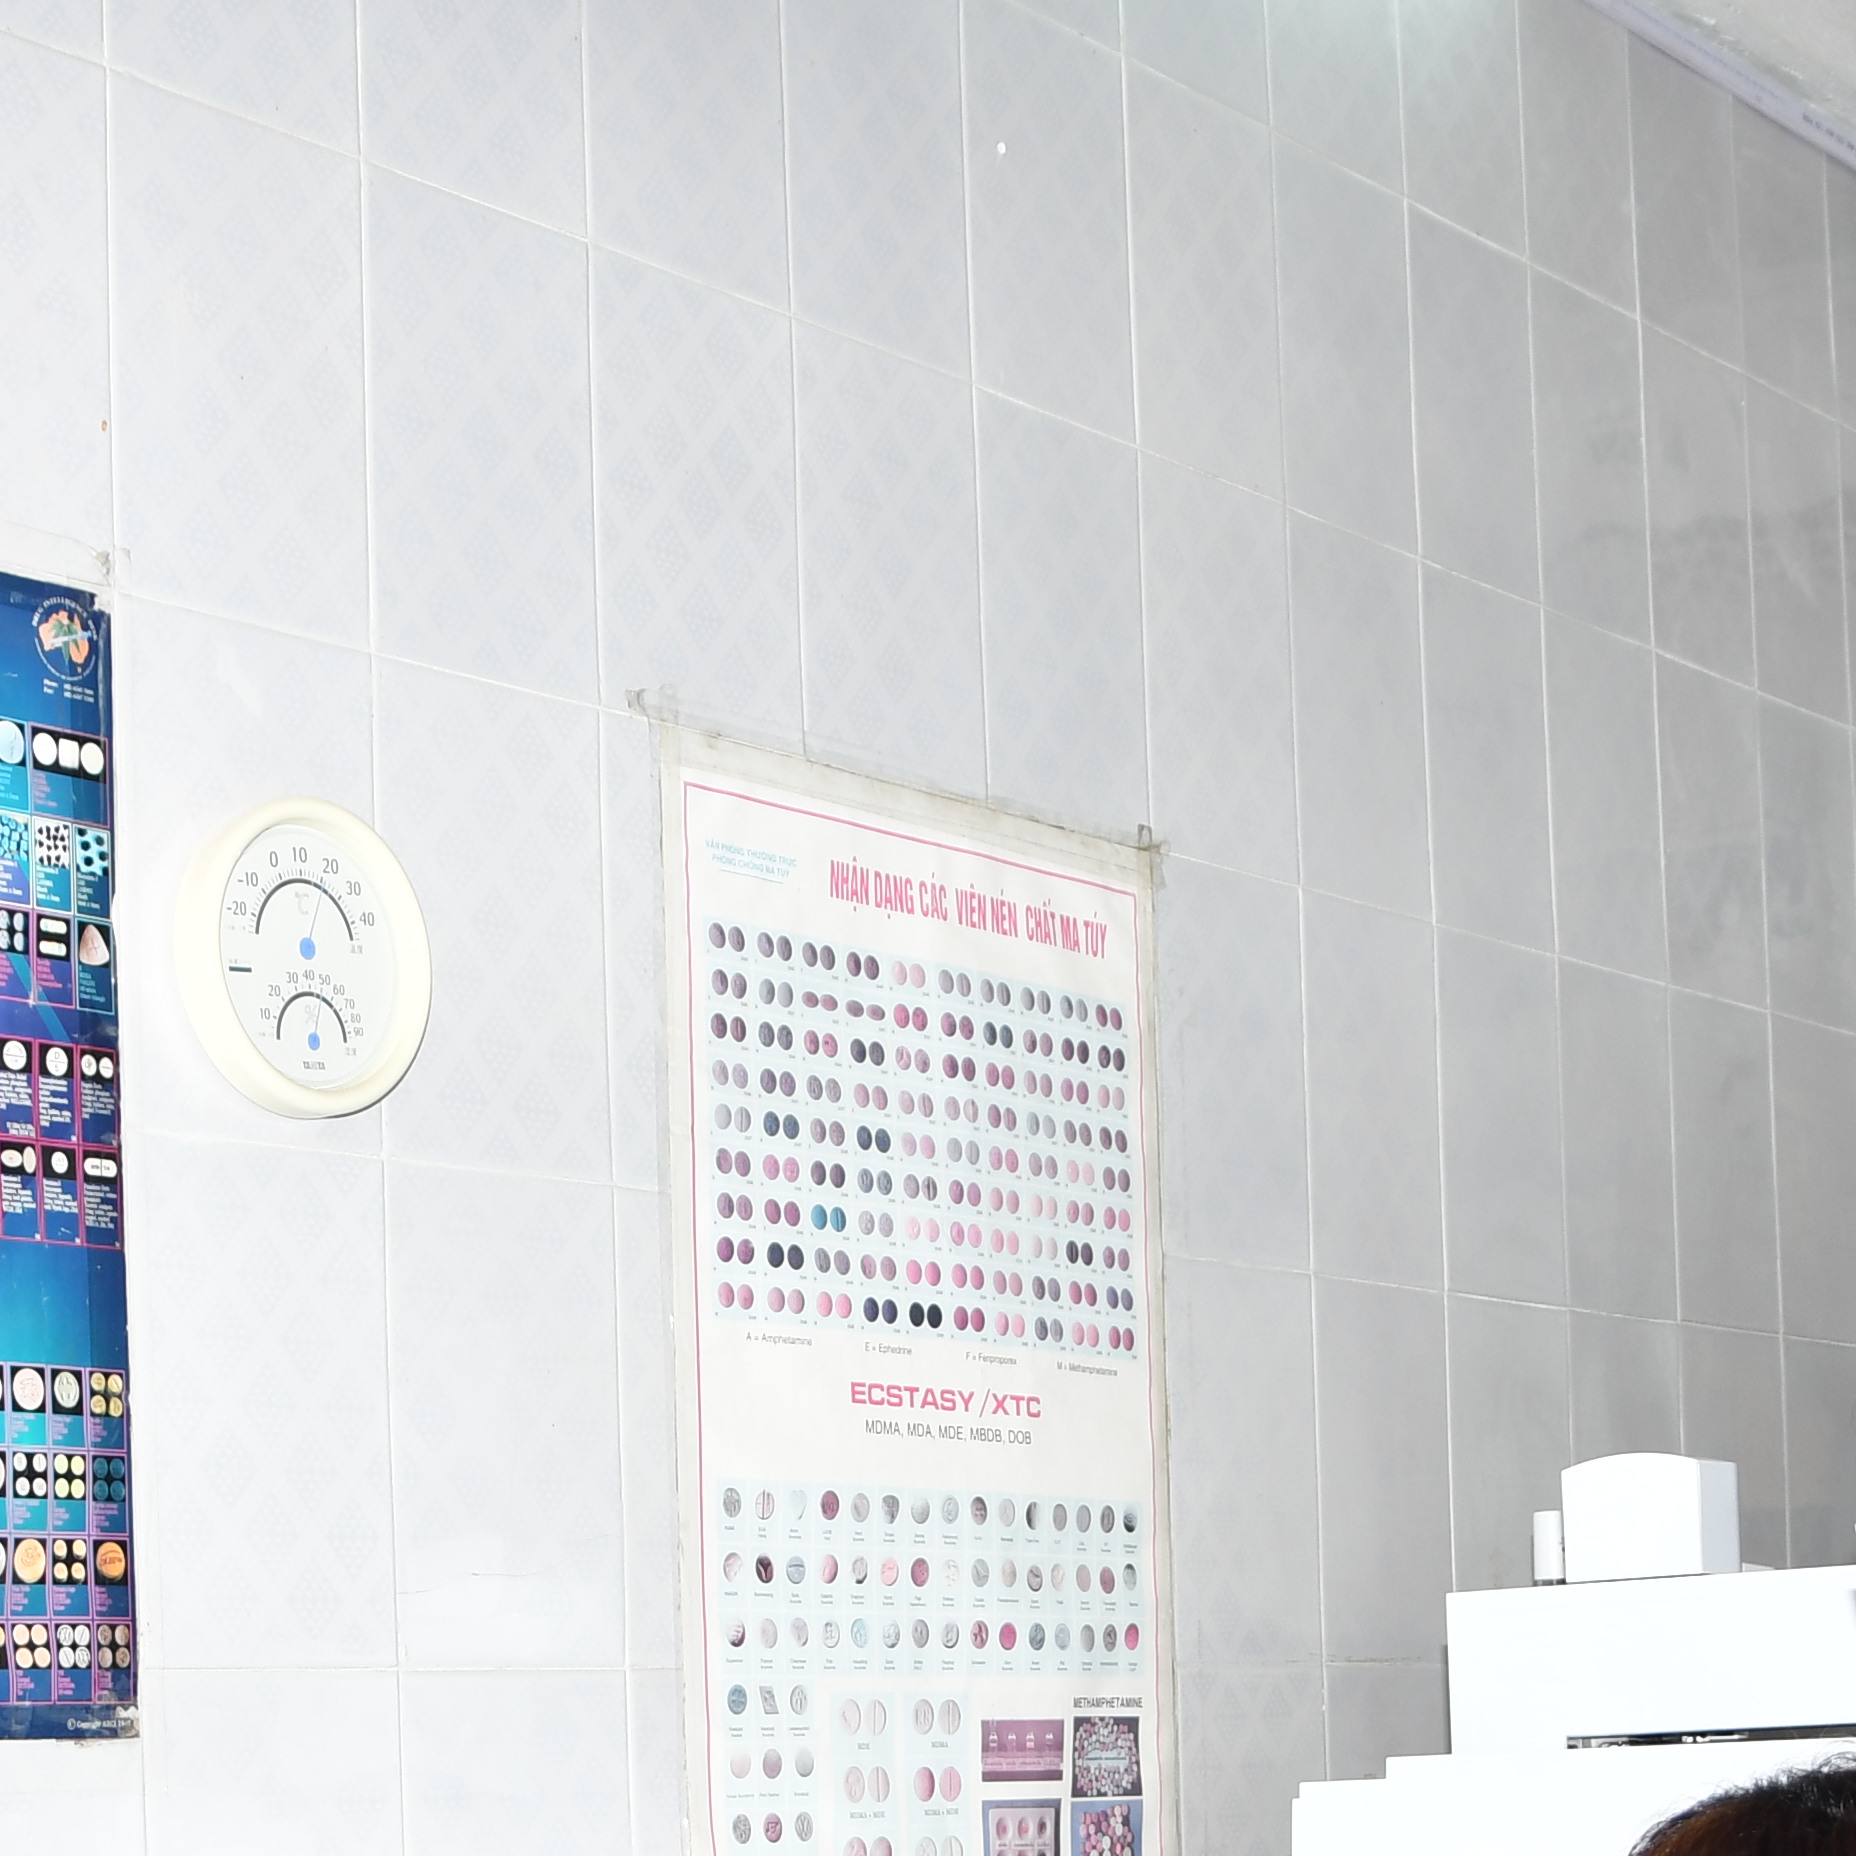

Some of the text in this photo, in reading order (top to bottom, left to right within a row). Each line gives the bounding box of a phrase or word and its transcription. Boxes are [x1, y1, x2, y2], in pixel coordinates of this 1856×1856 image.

[269, 851, 279, 868] 0
[292, 847, 308, 863] 10
[322, 858, 339, 875] 20
[237, 871, 259, 887] -10
[345, 881, 361, 896] 30
[226, 901, 247, 916] -20
[830, 856, 1108, 959] NHẬN DẠNG CÁC VIÊN NÉN CHẤT MA TÚY
[359, 911, 375, 927] 40
[285, 971, 299, 984] 30
[302, 969, 315, 981] 40
[318, 973, 331, 986] 50
[268, 984, 281, 997] 20
[333, 984, 345, 996] 60
[344, 999, 355, 1010] 70
[259, 1007, 271, 1021] 10
[350, 1013, 362, 1024] 80
[353, 1027, 364, 1037] 90
[850, 1381, 976, 1413] ECSTASY
[865, 1419, 1032, 1445] MDMA, MDA, MDE, MBDB, DOB
[1072, 1696, 1143, 1709] METHAMPHETAMINE
